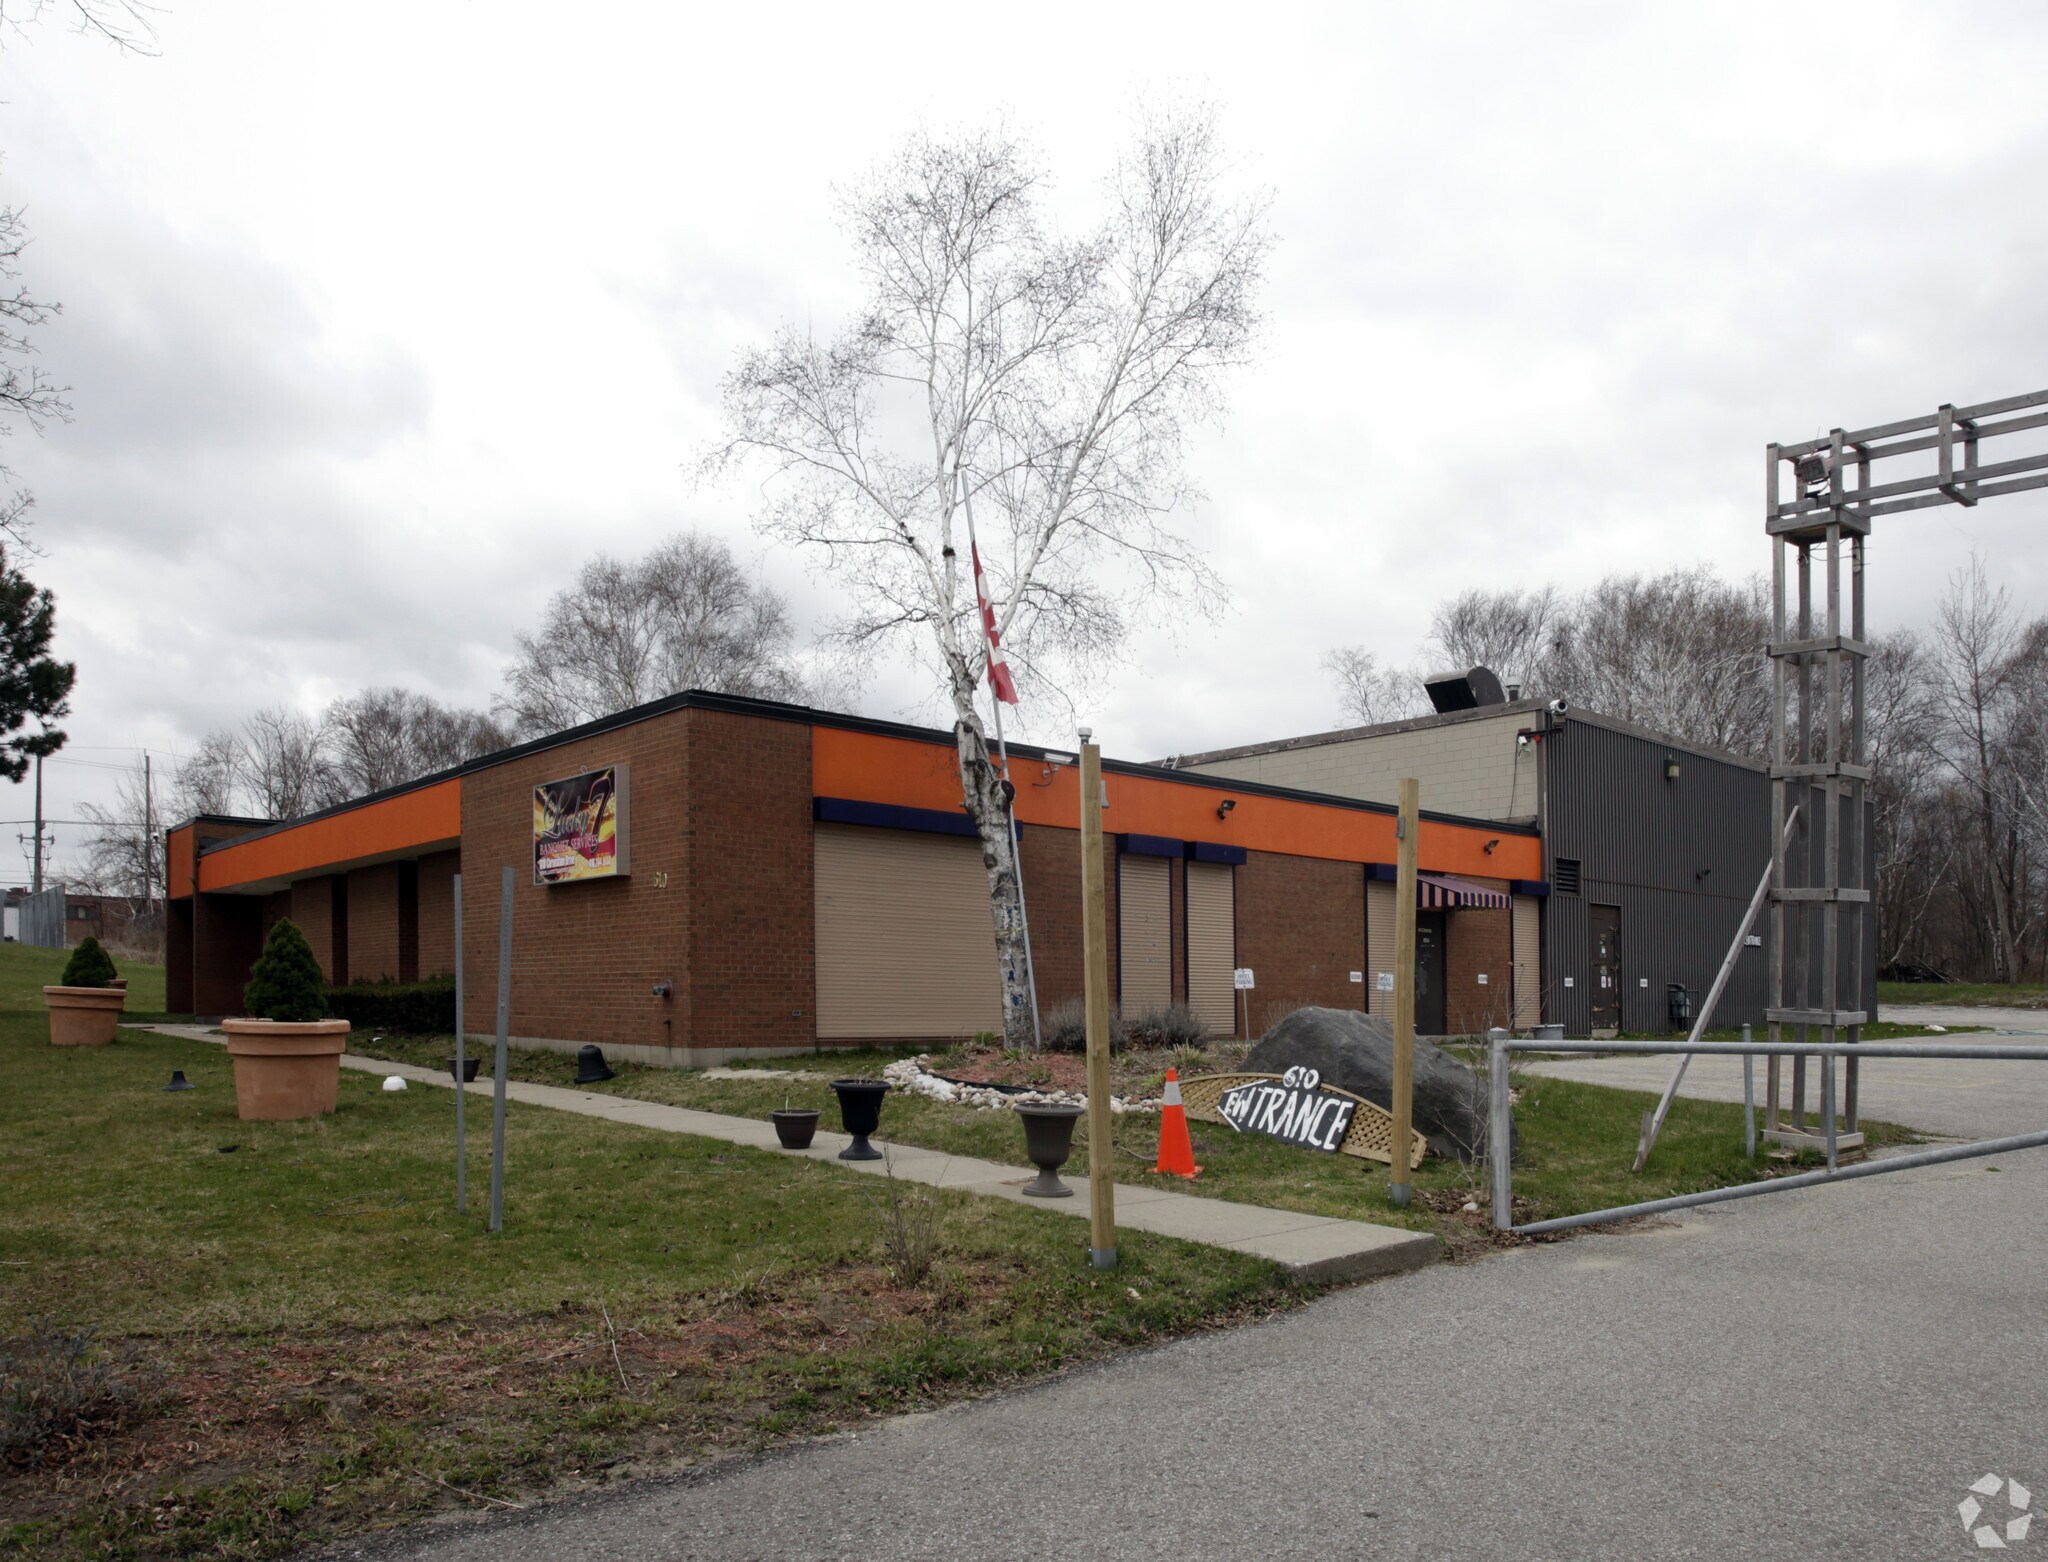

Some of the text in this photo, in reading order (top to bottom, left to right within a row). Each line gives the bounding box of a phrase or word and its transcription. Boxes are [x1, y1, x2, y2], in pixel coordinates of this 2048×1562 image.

[541, 789, 590, 838] Lucky
[539, 834, 598, 856] BANQUET SERVICES
[654, 871, 668, 888] 610
[1225, 1087, 1353, 1150] ENTRANCE
